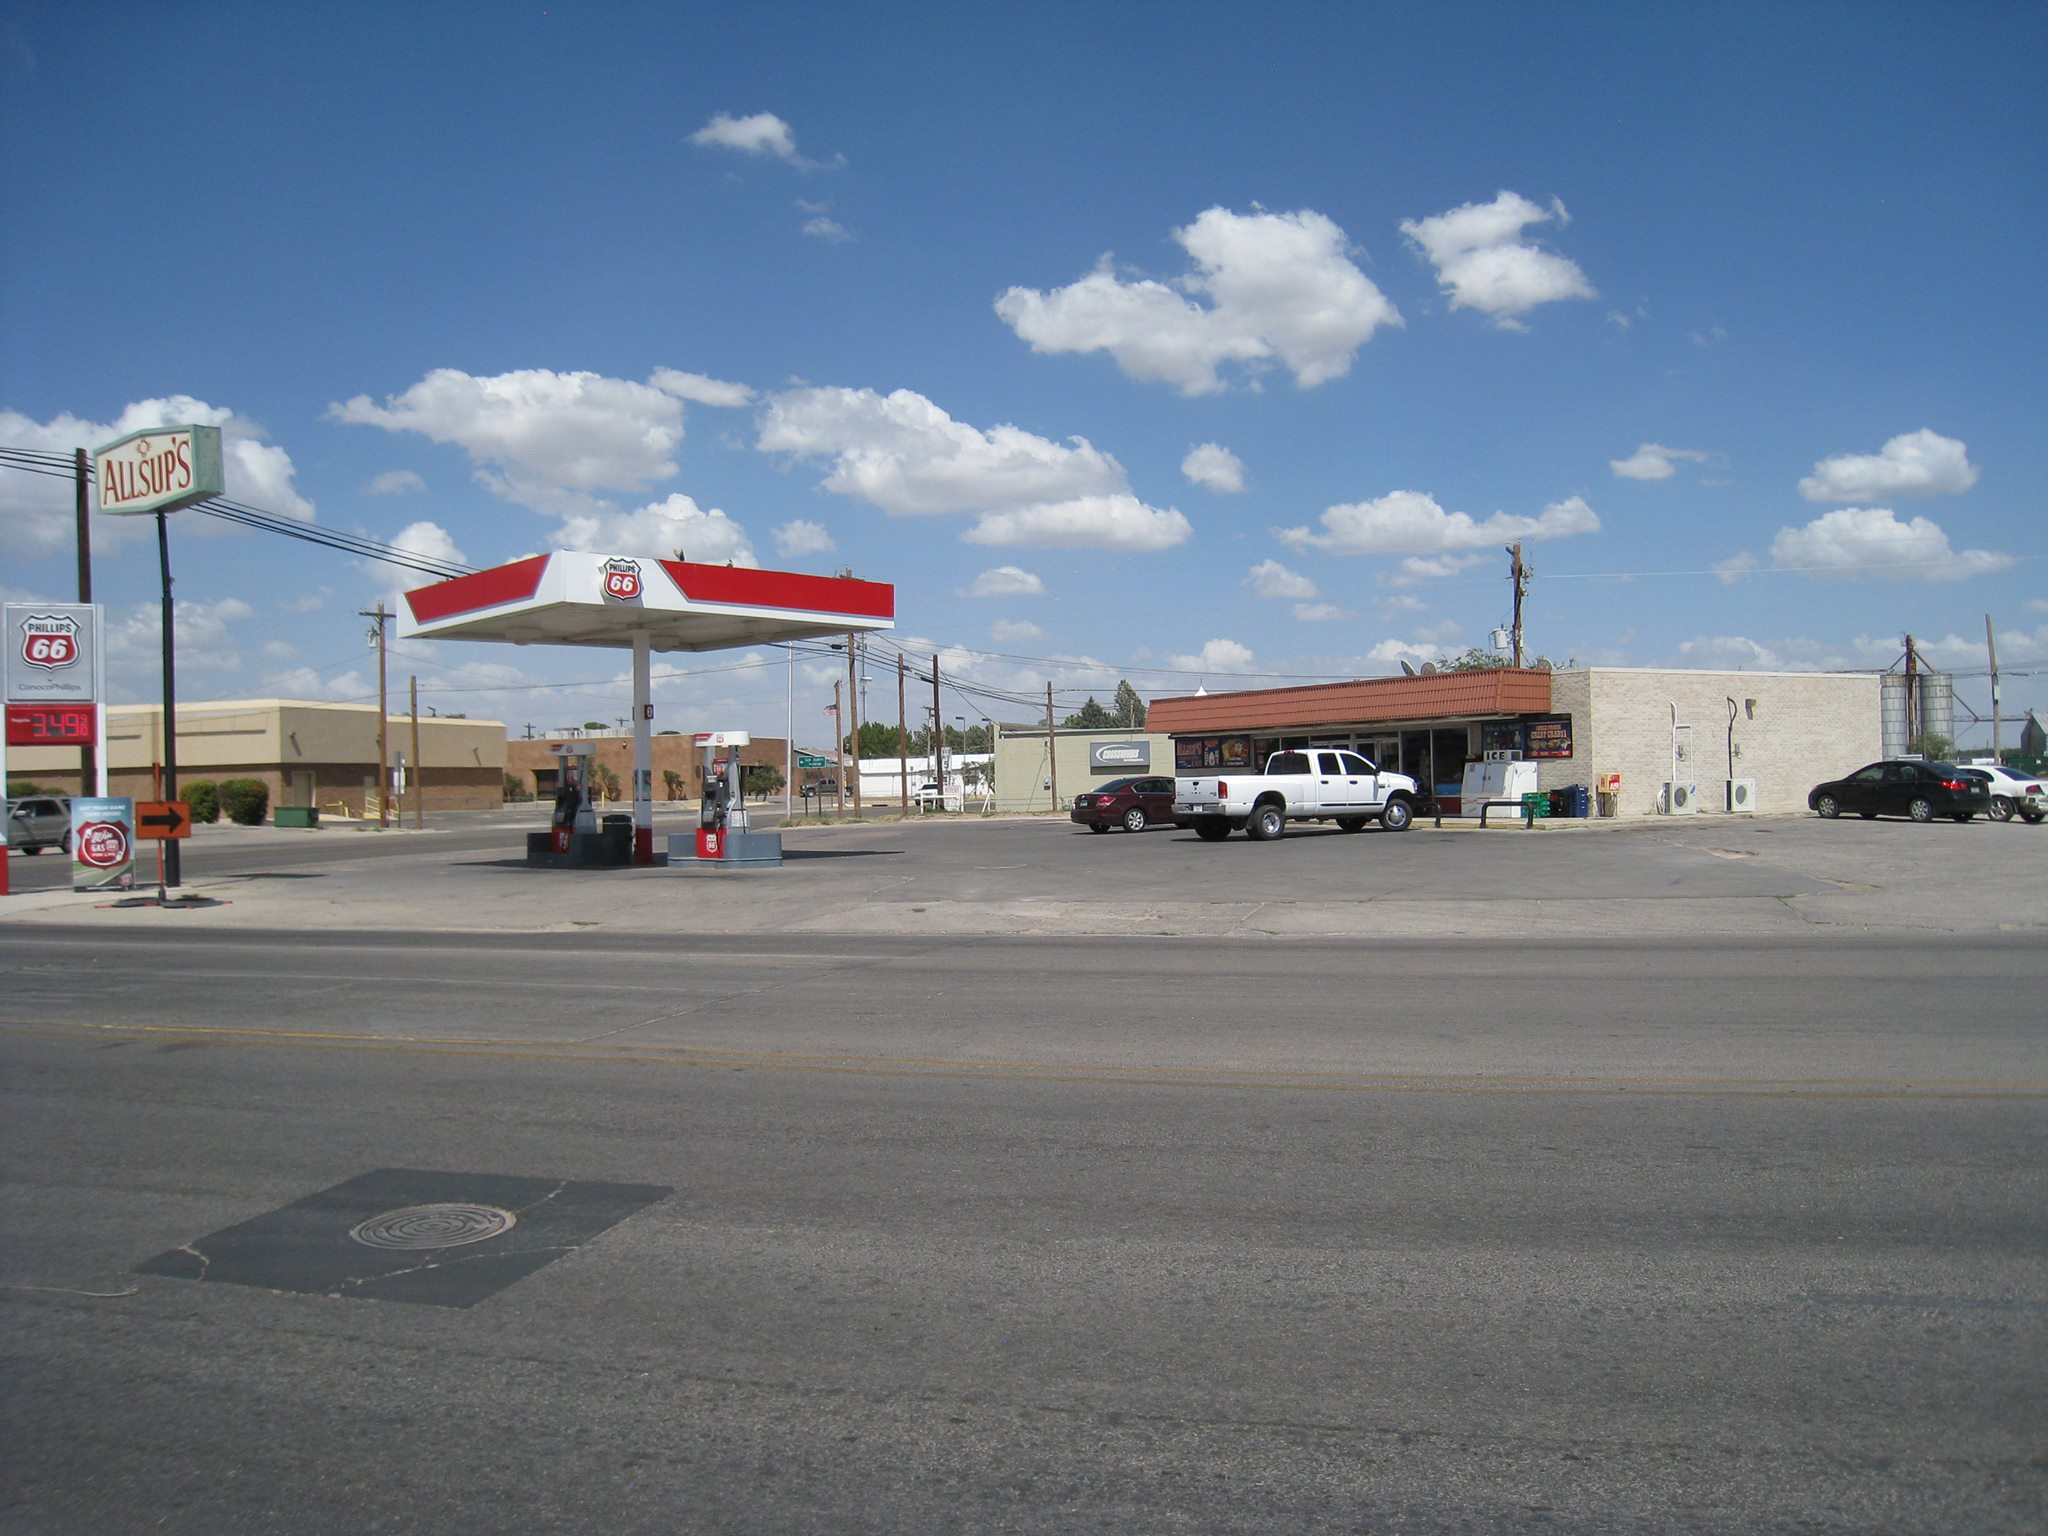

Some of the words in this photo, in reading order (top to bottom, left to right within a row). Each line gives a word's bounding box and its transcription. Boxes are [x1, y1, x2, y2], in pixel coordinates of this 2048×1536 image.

[103, 436, 191, 505] ALLSUP'S
[609, 564, 636, 573] PHILLIPS
[610, 575, 635, 592] 66
[28, 623, 73, 633] PHILLIPS
[32, 638, 68, 659] 66
[18, 683, 82, 692] ConocoPhillips
[1487, 751, 1506, 760] ICE
